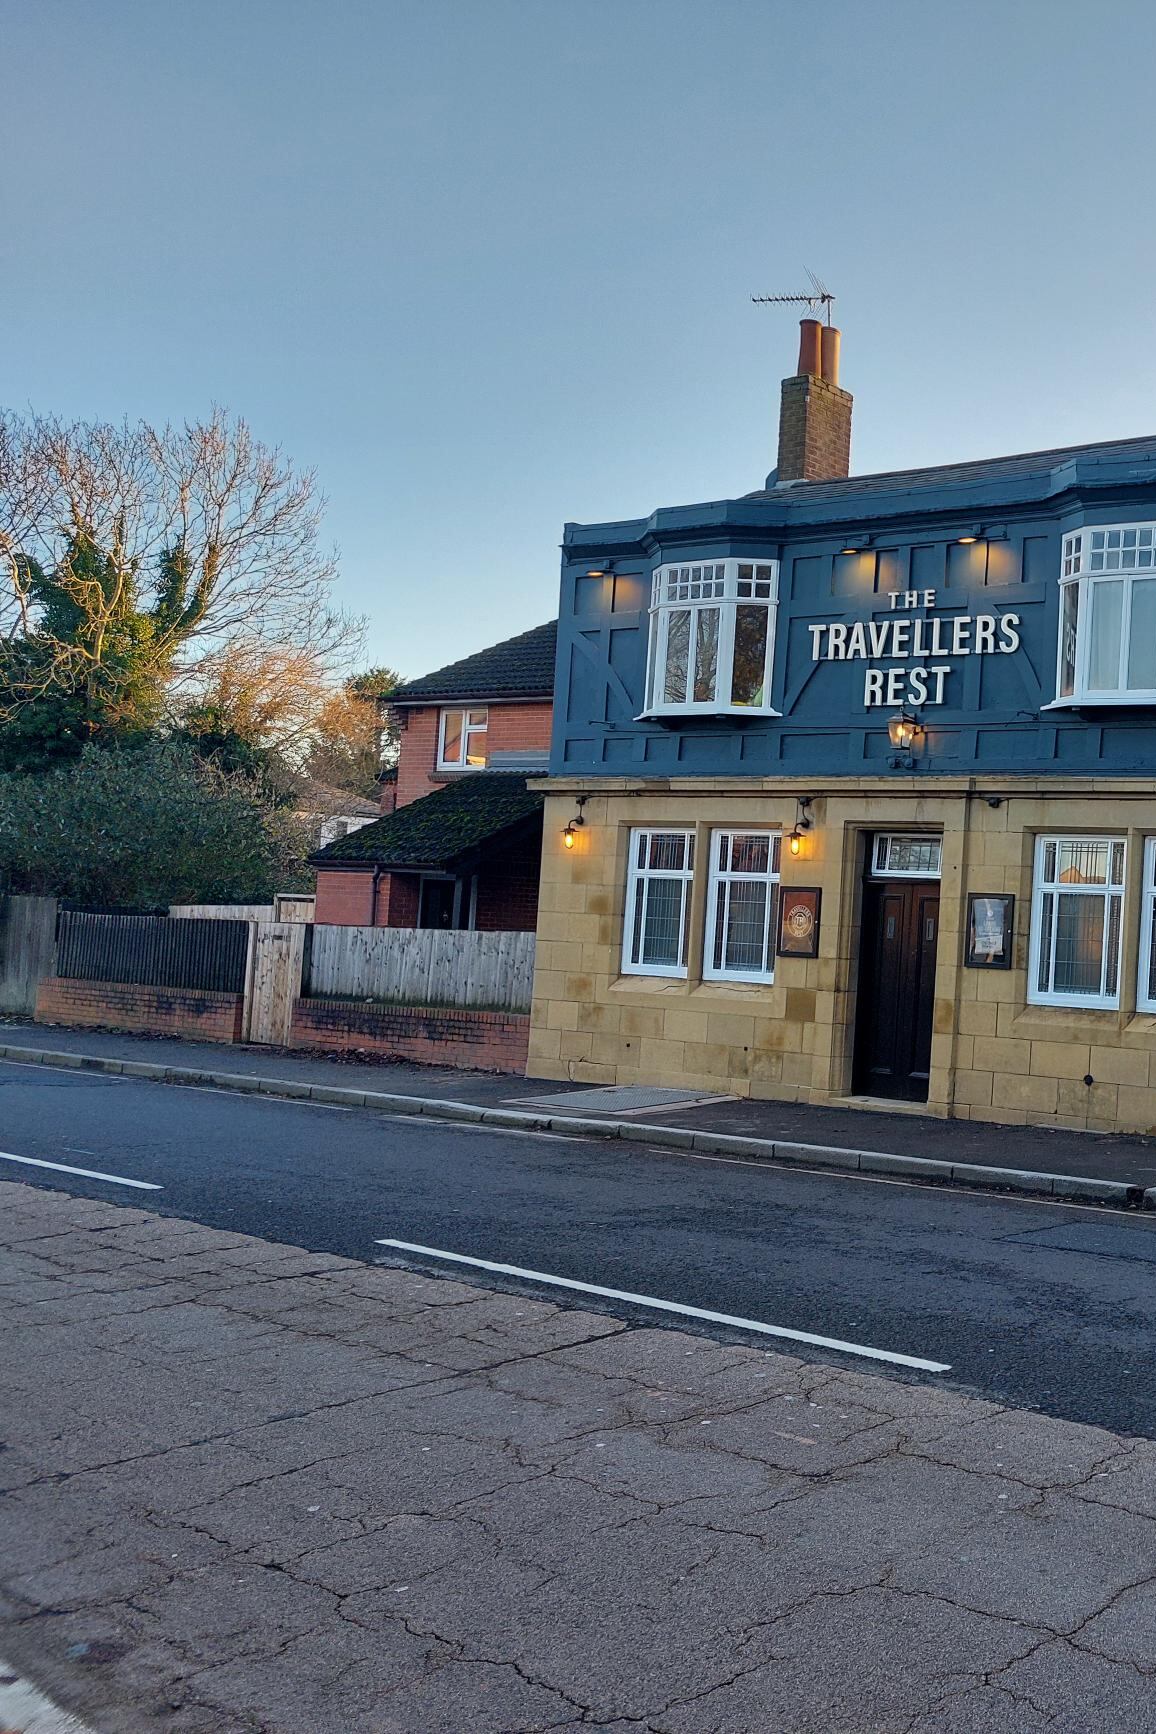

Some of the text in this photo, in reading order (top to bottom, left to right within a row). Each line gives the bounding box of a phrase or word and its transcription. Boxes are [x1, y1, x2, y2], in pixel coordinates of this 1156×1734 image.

[888, 589, 936, 610] THE
[808, 613, 1020, 661] TRAVELLERS
[864, 666, 951, 707] REST
